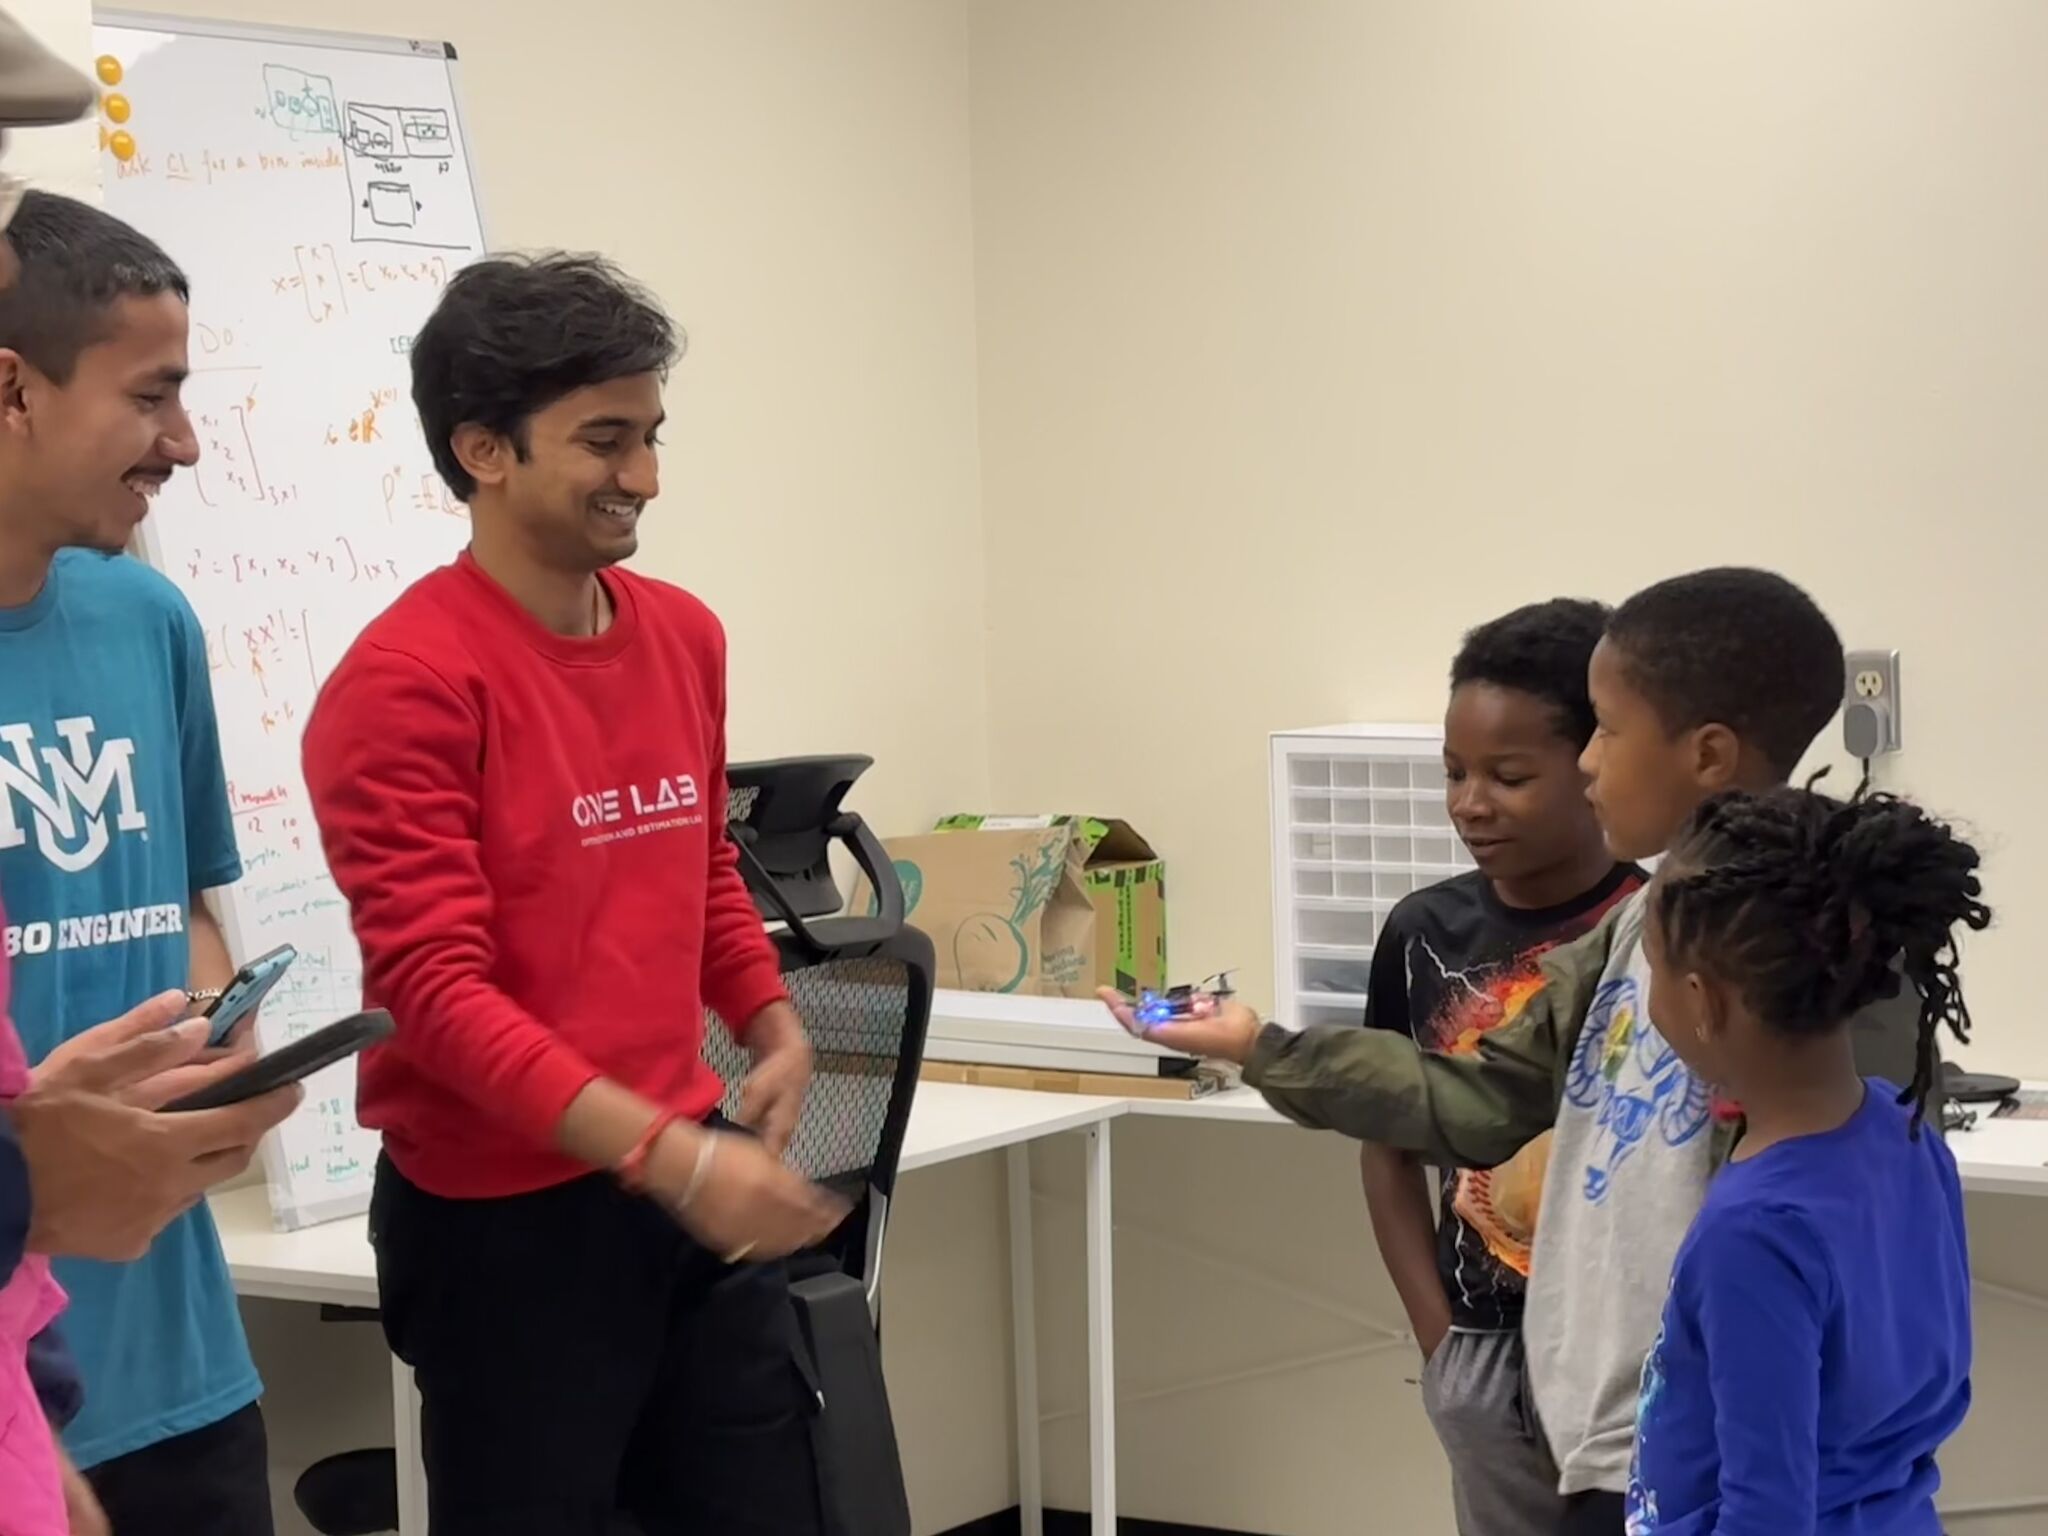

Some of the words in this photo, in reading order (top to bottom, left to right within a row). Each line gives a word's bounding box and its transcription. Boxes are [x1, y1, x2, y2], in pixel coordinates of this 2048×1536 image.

[572, 789, 622, 827] ONE
[629, 774, 699, 816] LAB
[3, 922, 52, 958] BO
[56, 903, 184, 950] ENGINER
